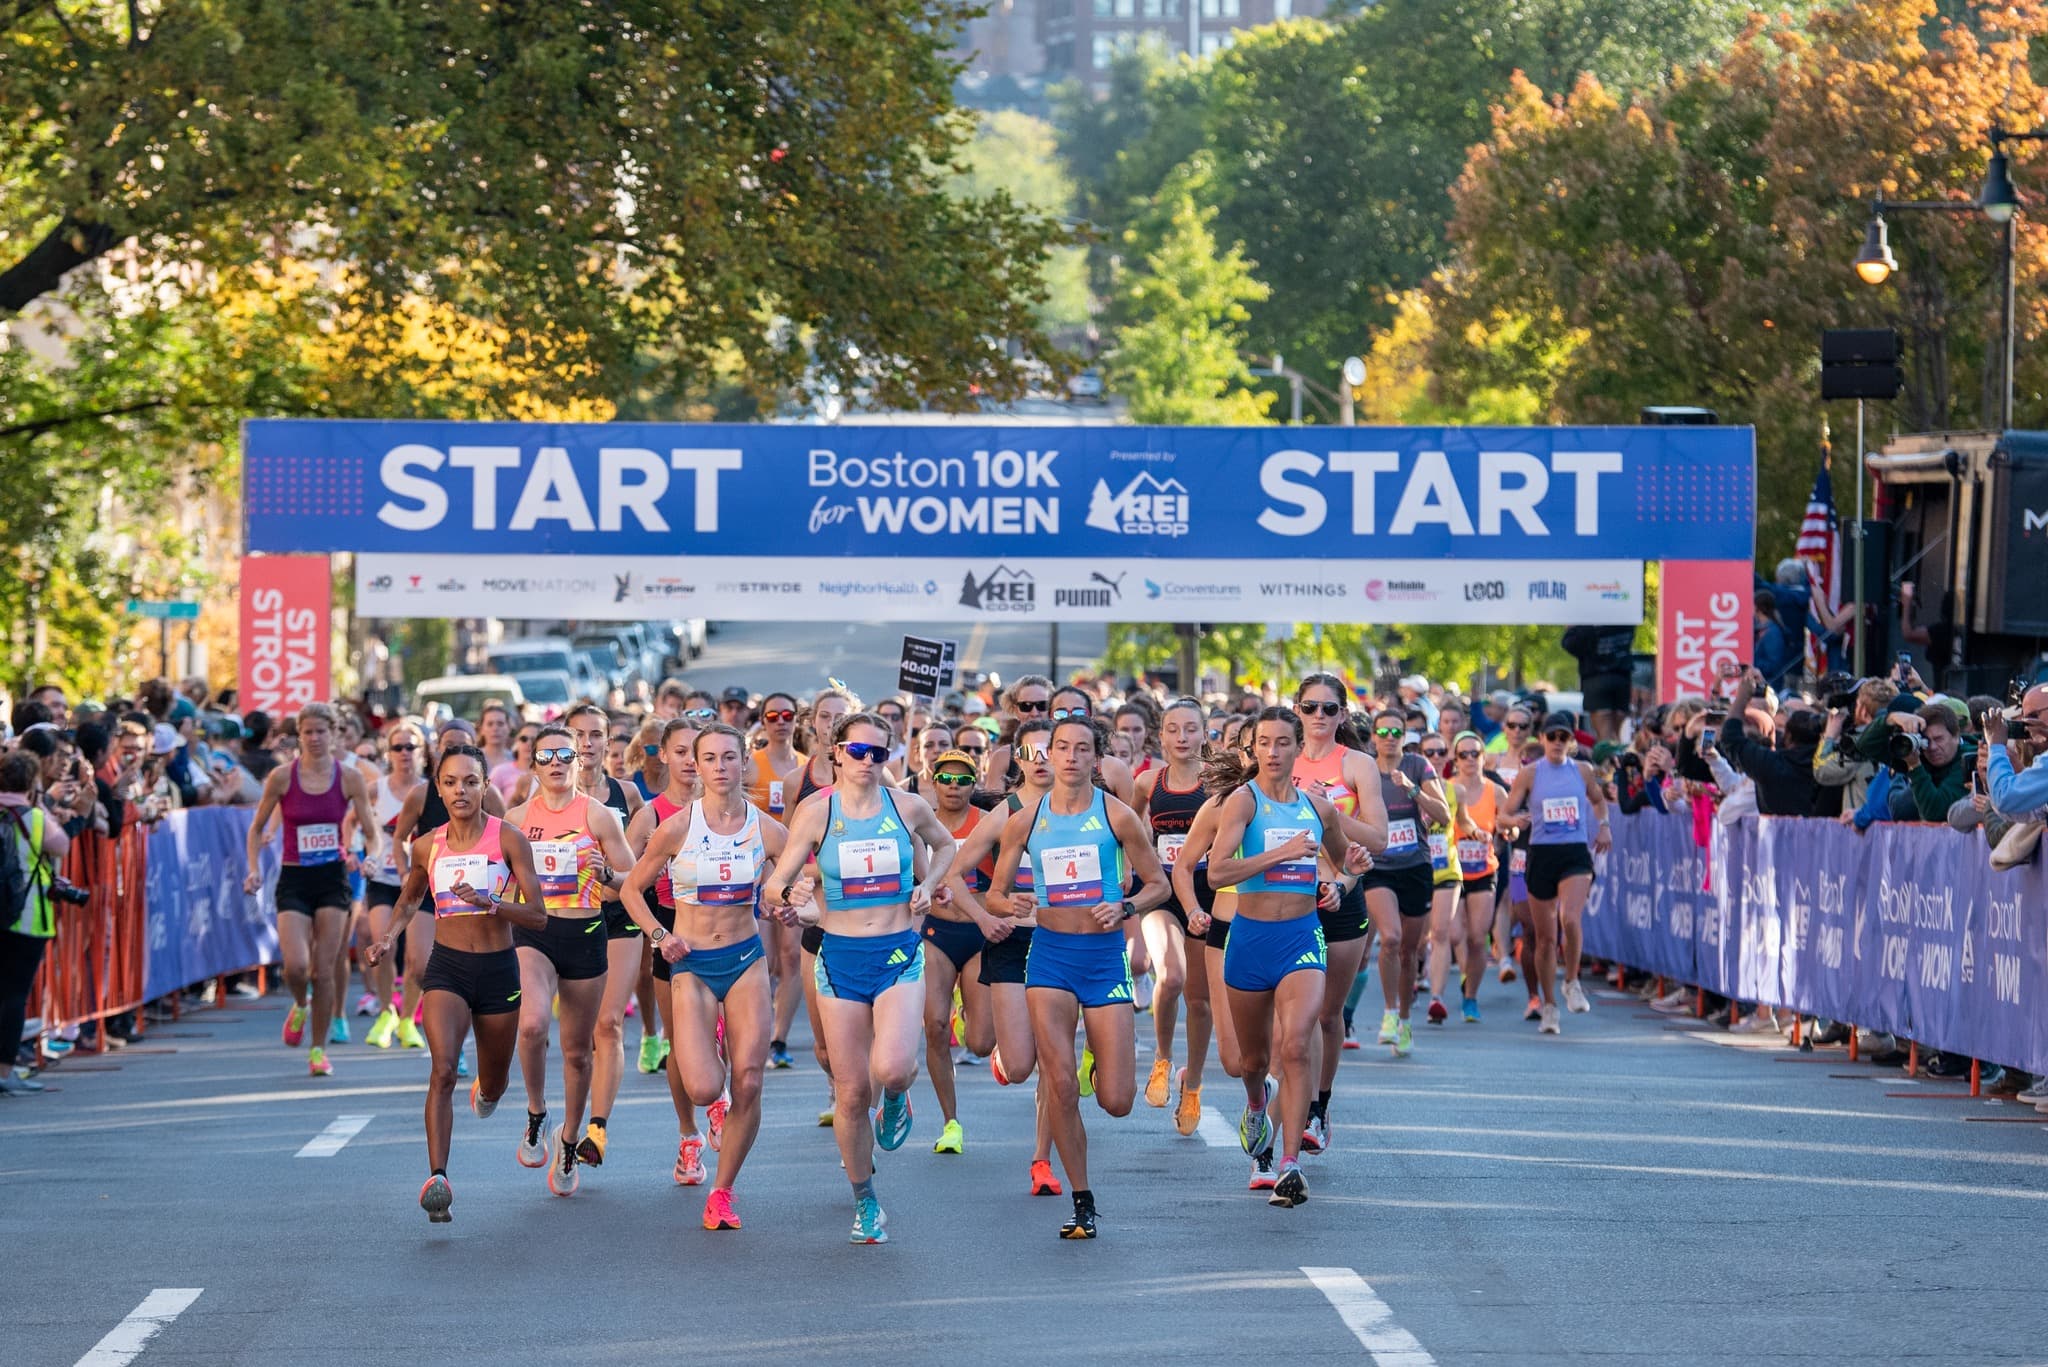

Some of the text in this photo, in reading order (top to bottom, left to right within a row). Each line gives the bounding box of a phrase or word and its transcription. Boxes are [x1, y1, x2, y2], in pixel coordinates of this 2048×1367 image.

[1110, 450, 1176, 463] Presented by
[808, 449, 1060, 488] Boston 10K
[377, 444, 742, 532] START
[1256, 449, 1623, 536] START
[808, 496, 1060, 534] for WOMEN
[1121, 494, 1189, 523] REI
[482, 579, 597, 593] MOVENATION
[818, 579, 918, 596] NeighborHealth
[986, 582, 1035, 601] REI
[1164, 581, 1241, 595] Conventures
[1260, 583, 1347, 597] WITHINGS
[1464, 580, 1505, 602] LOCO
[1528, 580, 1567, 601] POLAR
[1055, 588, 1111, 607] PUMA
[252, 588, 283, 719] STRON
[1675, 610, 1706, 704] TART
[285, 609, 316, 718] STAR
[901, 660, 939, 677] 40:00
[302, 834, 335, 849] 1055
[852, 846, 876, 854] WOMEN
[544, 855, 557, 873] 9
[864, 854, 873, 873] 1
[1054, 853, 1076, 861] WOMEN
[719, 863, 732, 882] 5
[1065, 861, 1078, 880] 4
[1062, 892, 1087, 901] Bethany
